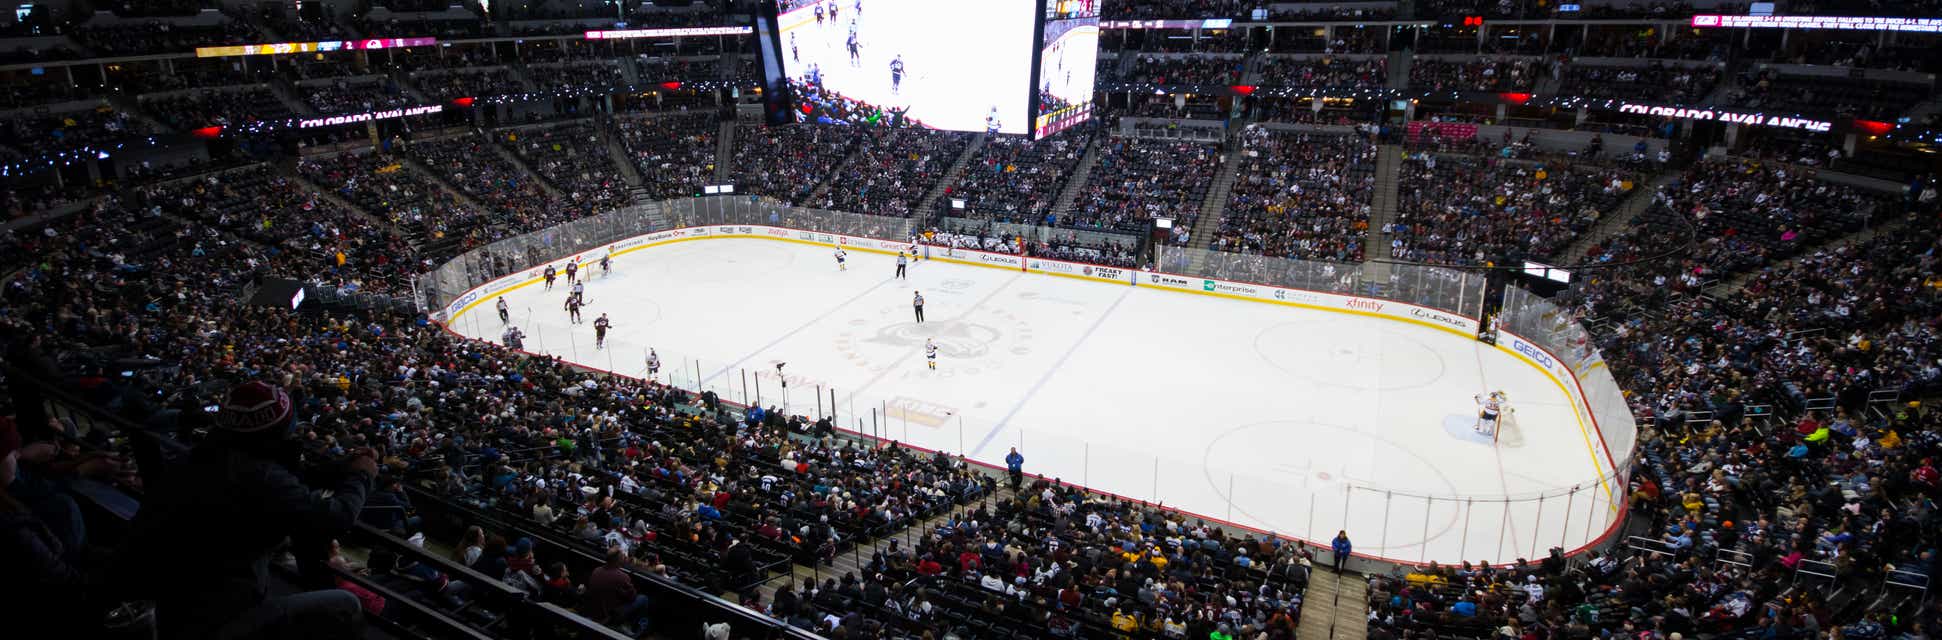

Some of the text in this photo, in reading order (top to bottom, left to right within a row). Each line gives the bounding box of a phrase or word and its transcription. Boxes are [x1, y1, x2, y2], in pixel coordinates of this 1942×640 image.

[1095, 267, 1122, 276] FREAKY
[451, 292, 477, 312] GEICO
[1345, 298, 1384, 312] xfinity
[1513, 340, 1553, 369] GEICO
